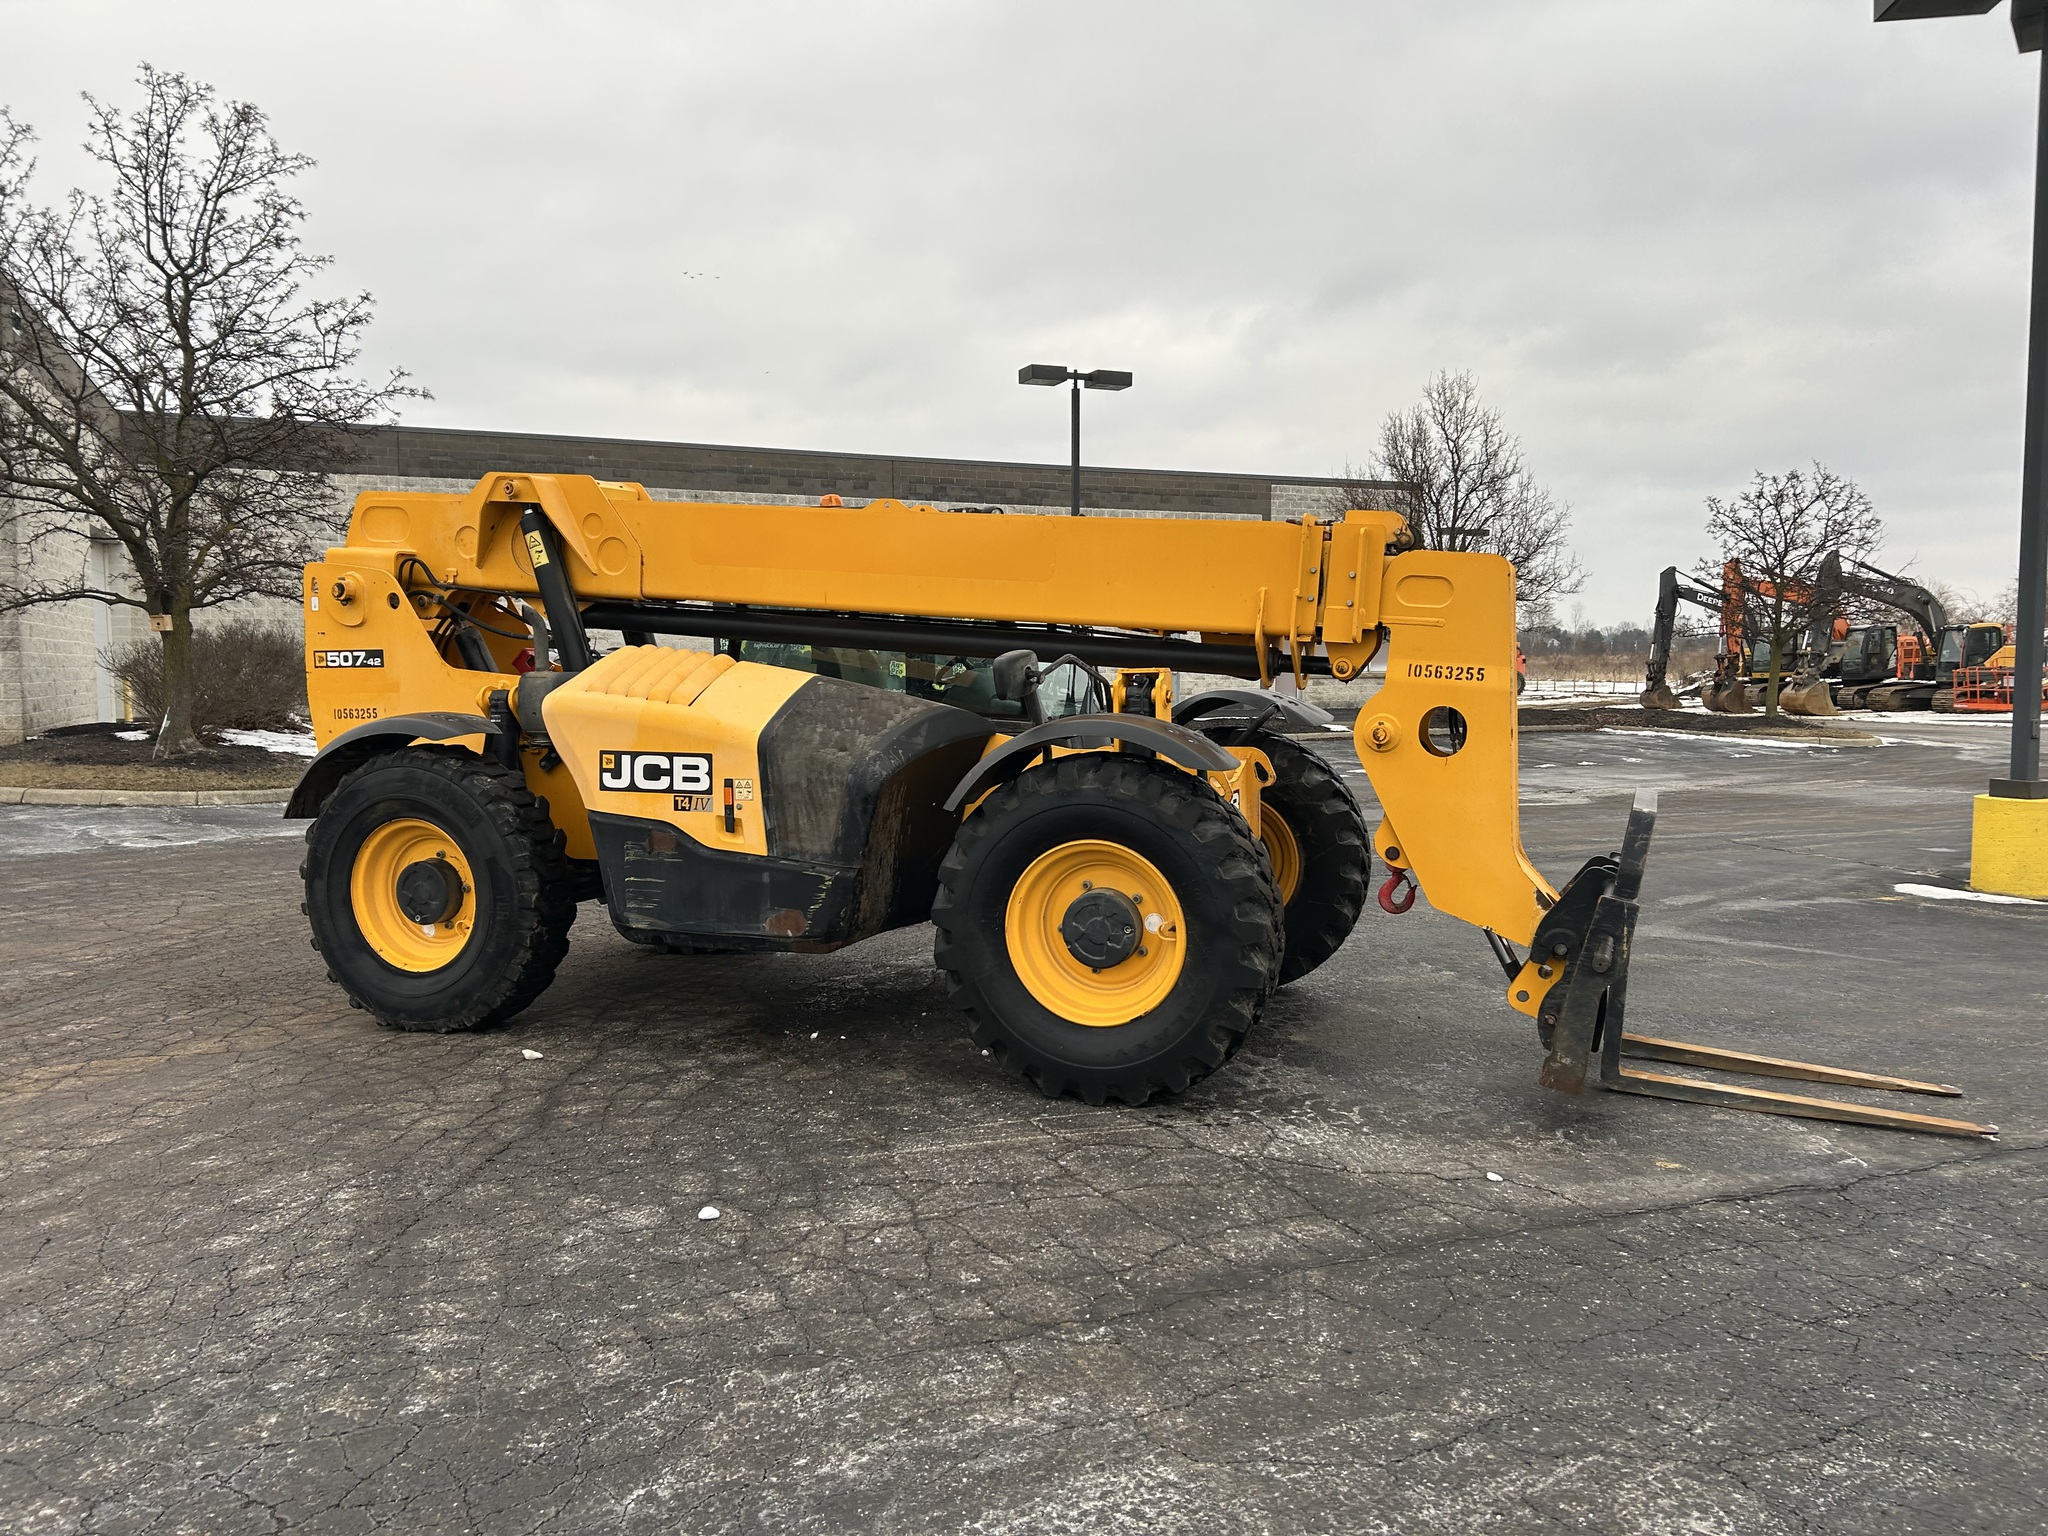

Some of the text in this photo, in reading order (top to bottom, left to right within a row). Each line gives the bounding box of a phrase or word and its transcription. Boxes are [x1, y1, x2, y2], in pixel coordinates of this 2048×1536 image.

[1408, 663, 1485, 681] 10563255
[333, 708, 378, 719] 10563255
[602, 754, 710, 791] JCB
[675, 796, 711, 810] T4 IV
